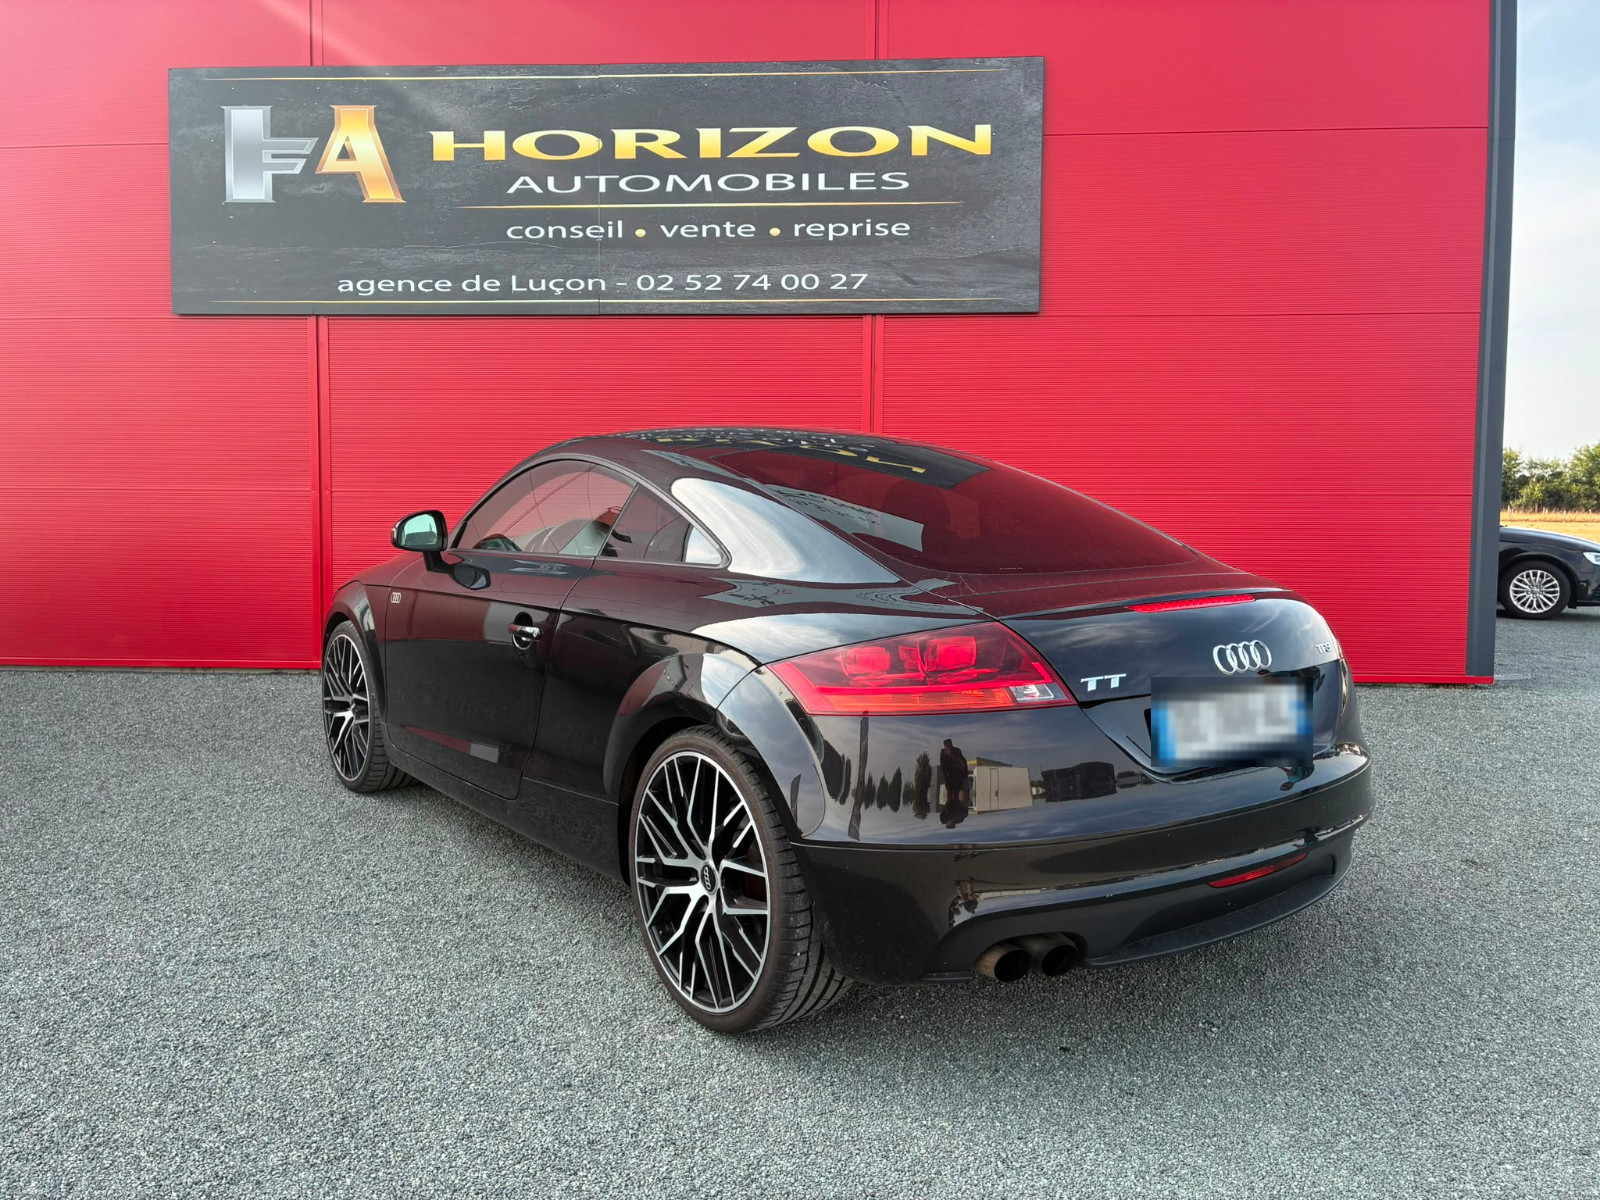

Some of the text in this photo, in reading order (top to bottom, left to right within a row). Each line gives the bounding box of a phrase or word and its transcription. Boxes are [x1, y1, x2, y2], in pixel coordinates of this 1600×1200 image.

[429, 124, 991, 162] HORIZON
[506, 172, 910, 194] AUTOMOBILES
[506, 219, 911, 241] conseil vente reprise
[337, 279, 453, 296] agence
[461, 274, 501, 292] de
[511, 274, 606, 296] Luçon
[636, 274, 674, 291] 02
[684, 274, 723, 291] 52
[733, 274, 772, 291] 74
[780, 273, 820, 291] 00
[829, 273, 869, 290] 27
[1080, 673, 1127, 692] TT
